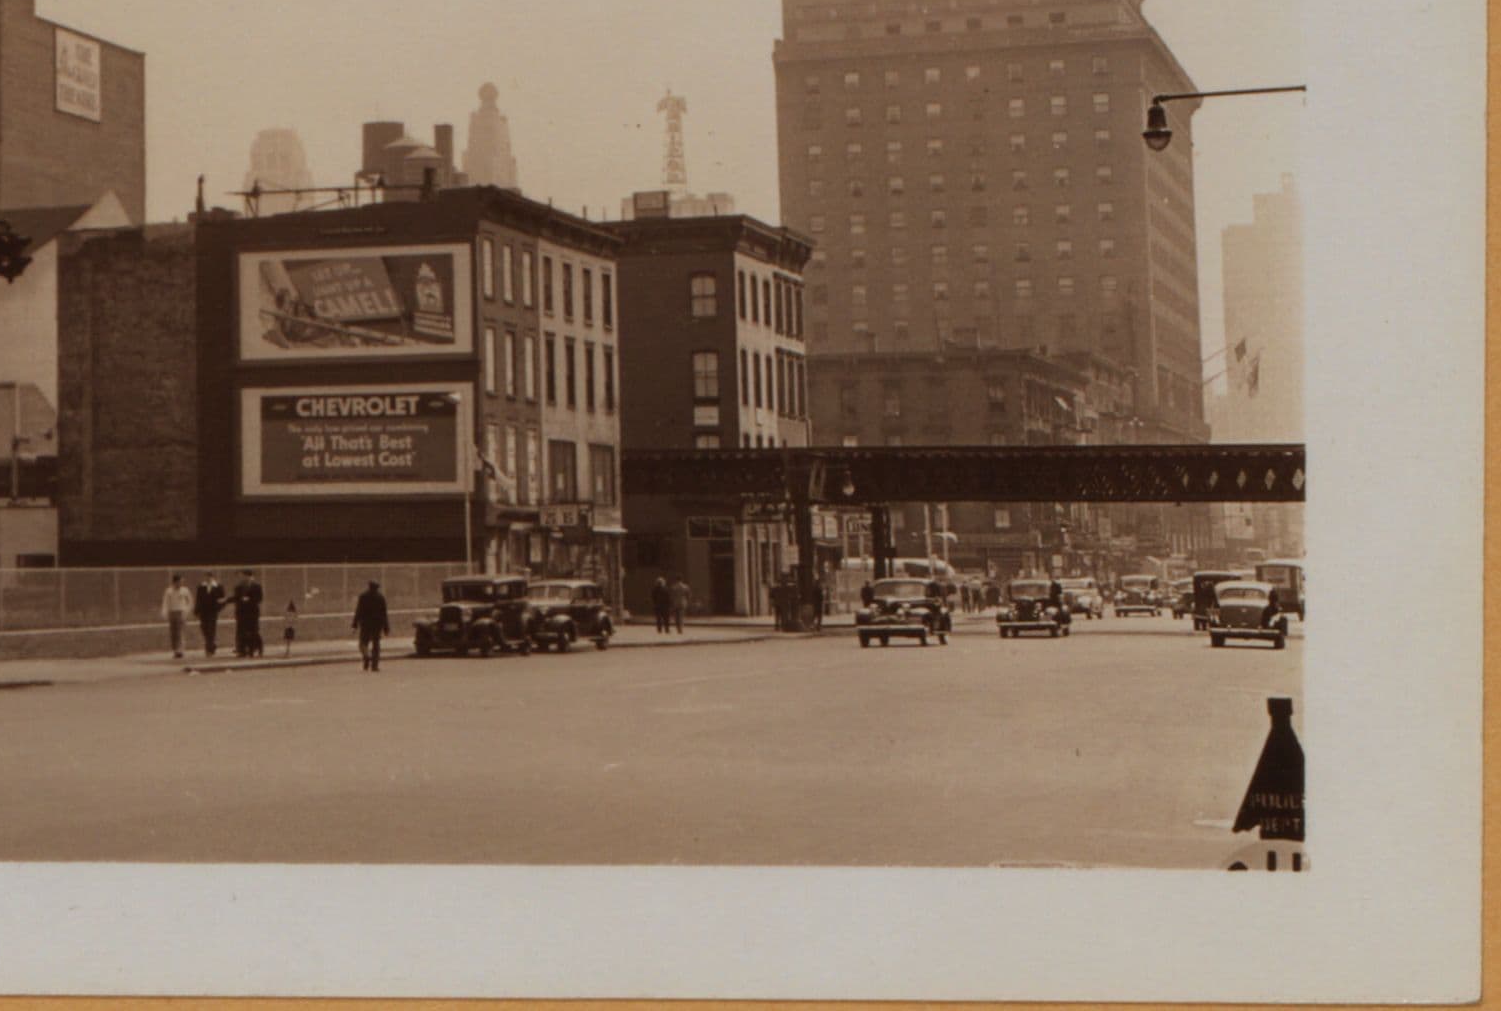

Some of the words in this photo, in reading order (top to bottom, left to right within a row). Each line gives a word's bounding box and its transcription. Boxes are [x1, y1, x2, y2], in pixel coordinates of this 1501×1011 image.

[296, 396, 420, 417] CHEVROLET
[330, 434, 373, 451] That's
[379, 433, 412, 451] Best
[301, 453, 320, 468] at
[324, 452, 375, 468] Lowest
